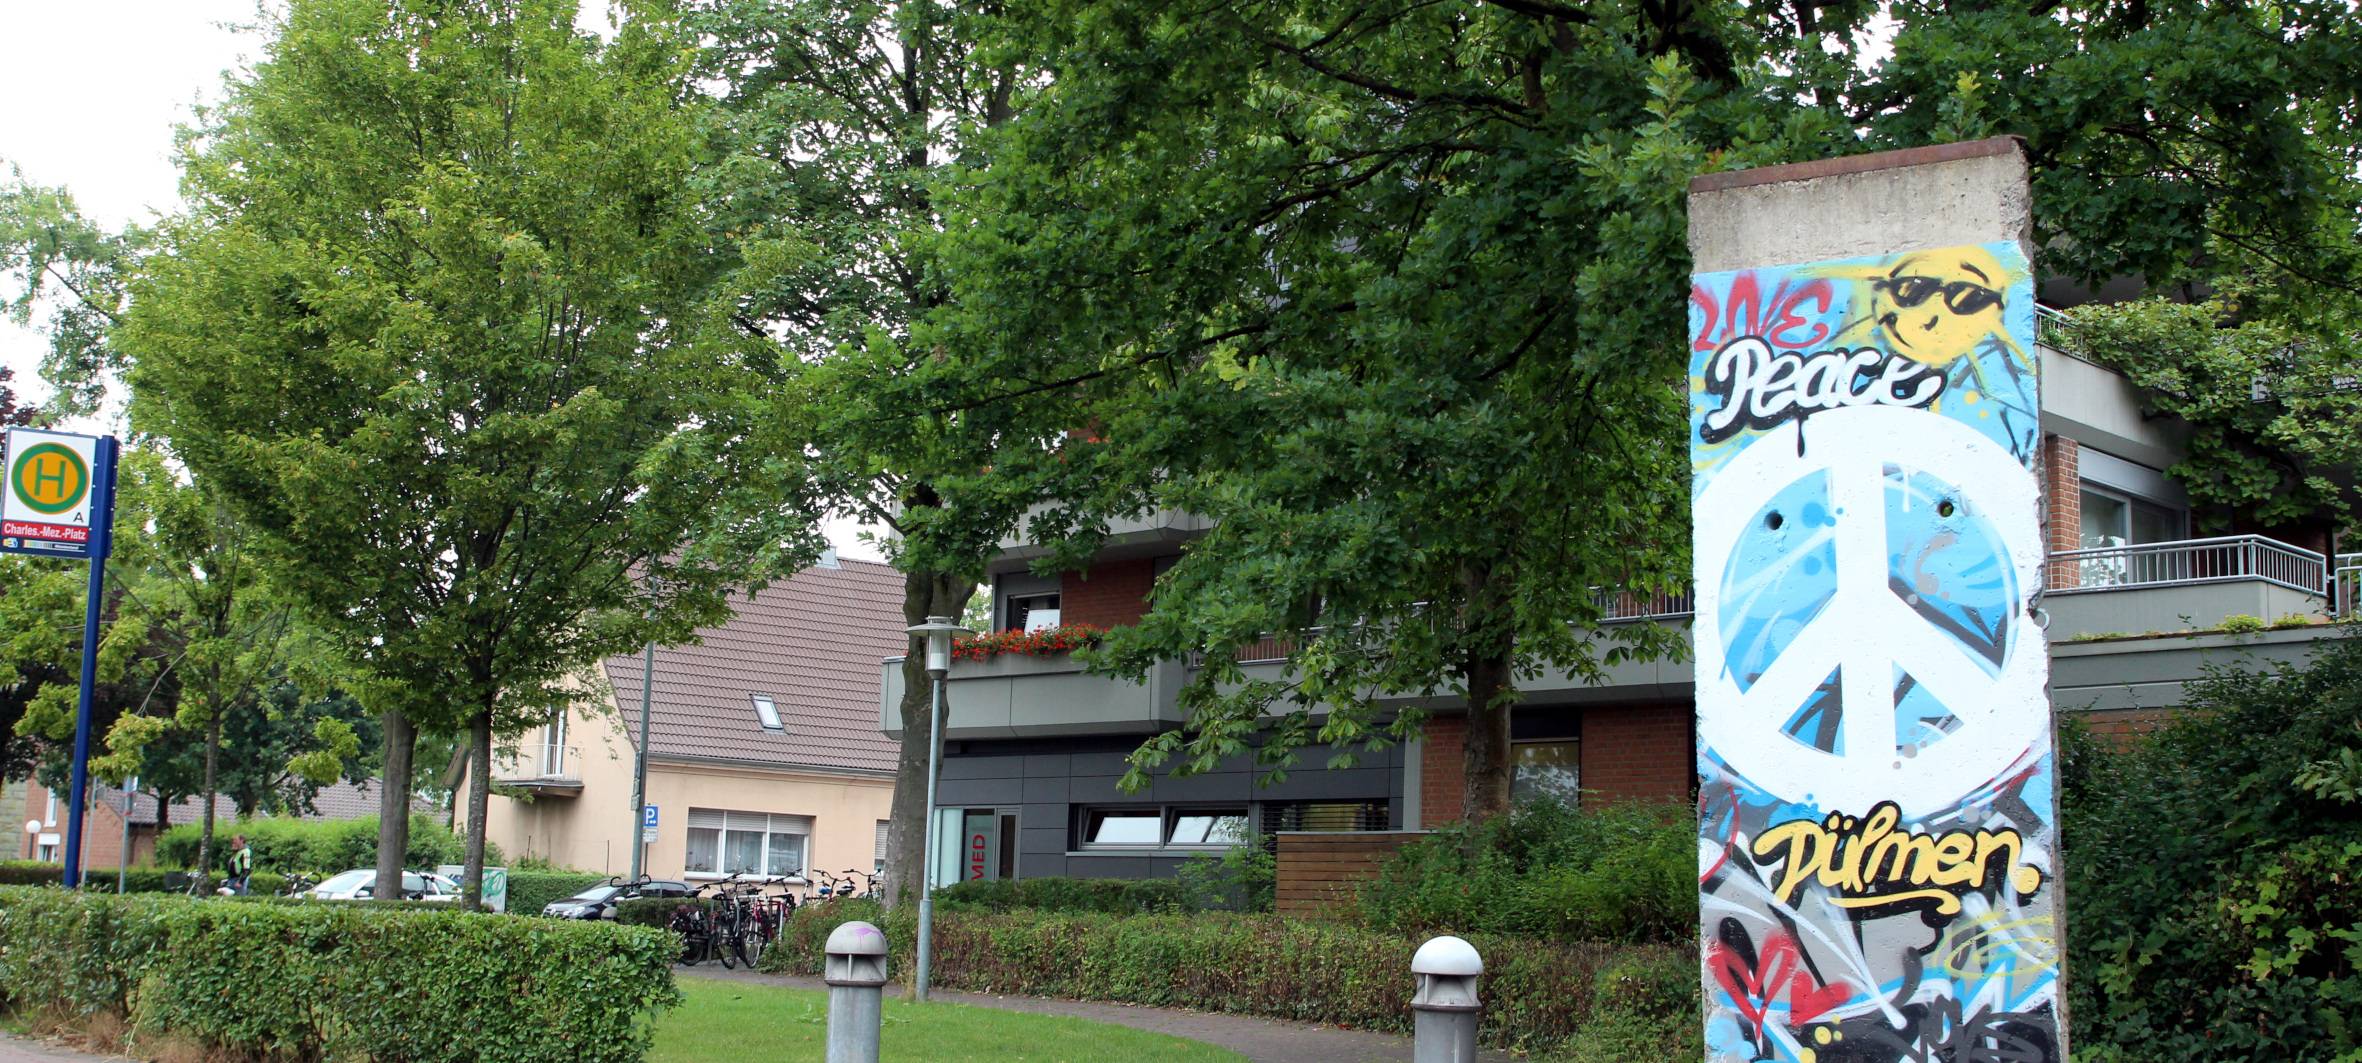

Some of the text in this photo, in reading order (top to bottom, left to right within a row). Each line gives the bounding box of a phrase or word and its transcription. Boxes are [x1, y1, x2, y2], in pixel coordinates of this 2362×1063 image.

[1702, 336, 1946, 442] Peace
[34, 457, 67, 498] H
[73, 512, 84, 523] A
[645, 808, 655, 824] P
[1753, 800, 2043, 906] Dülmen
